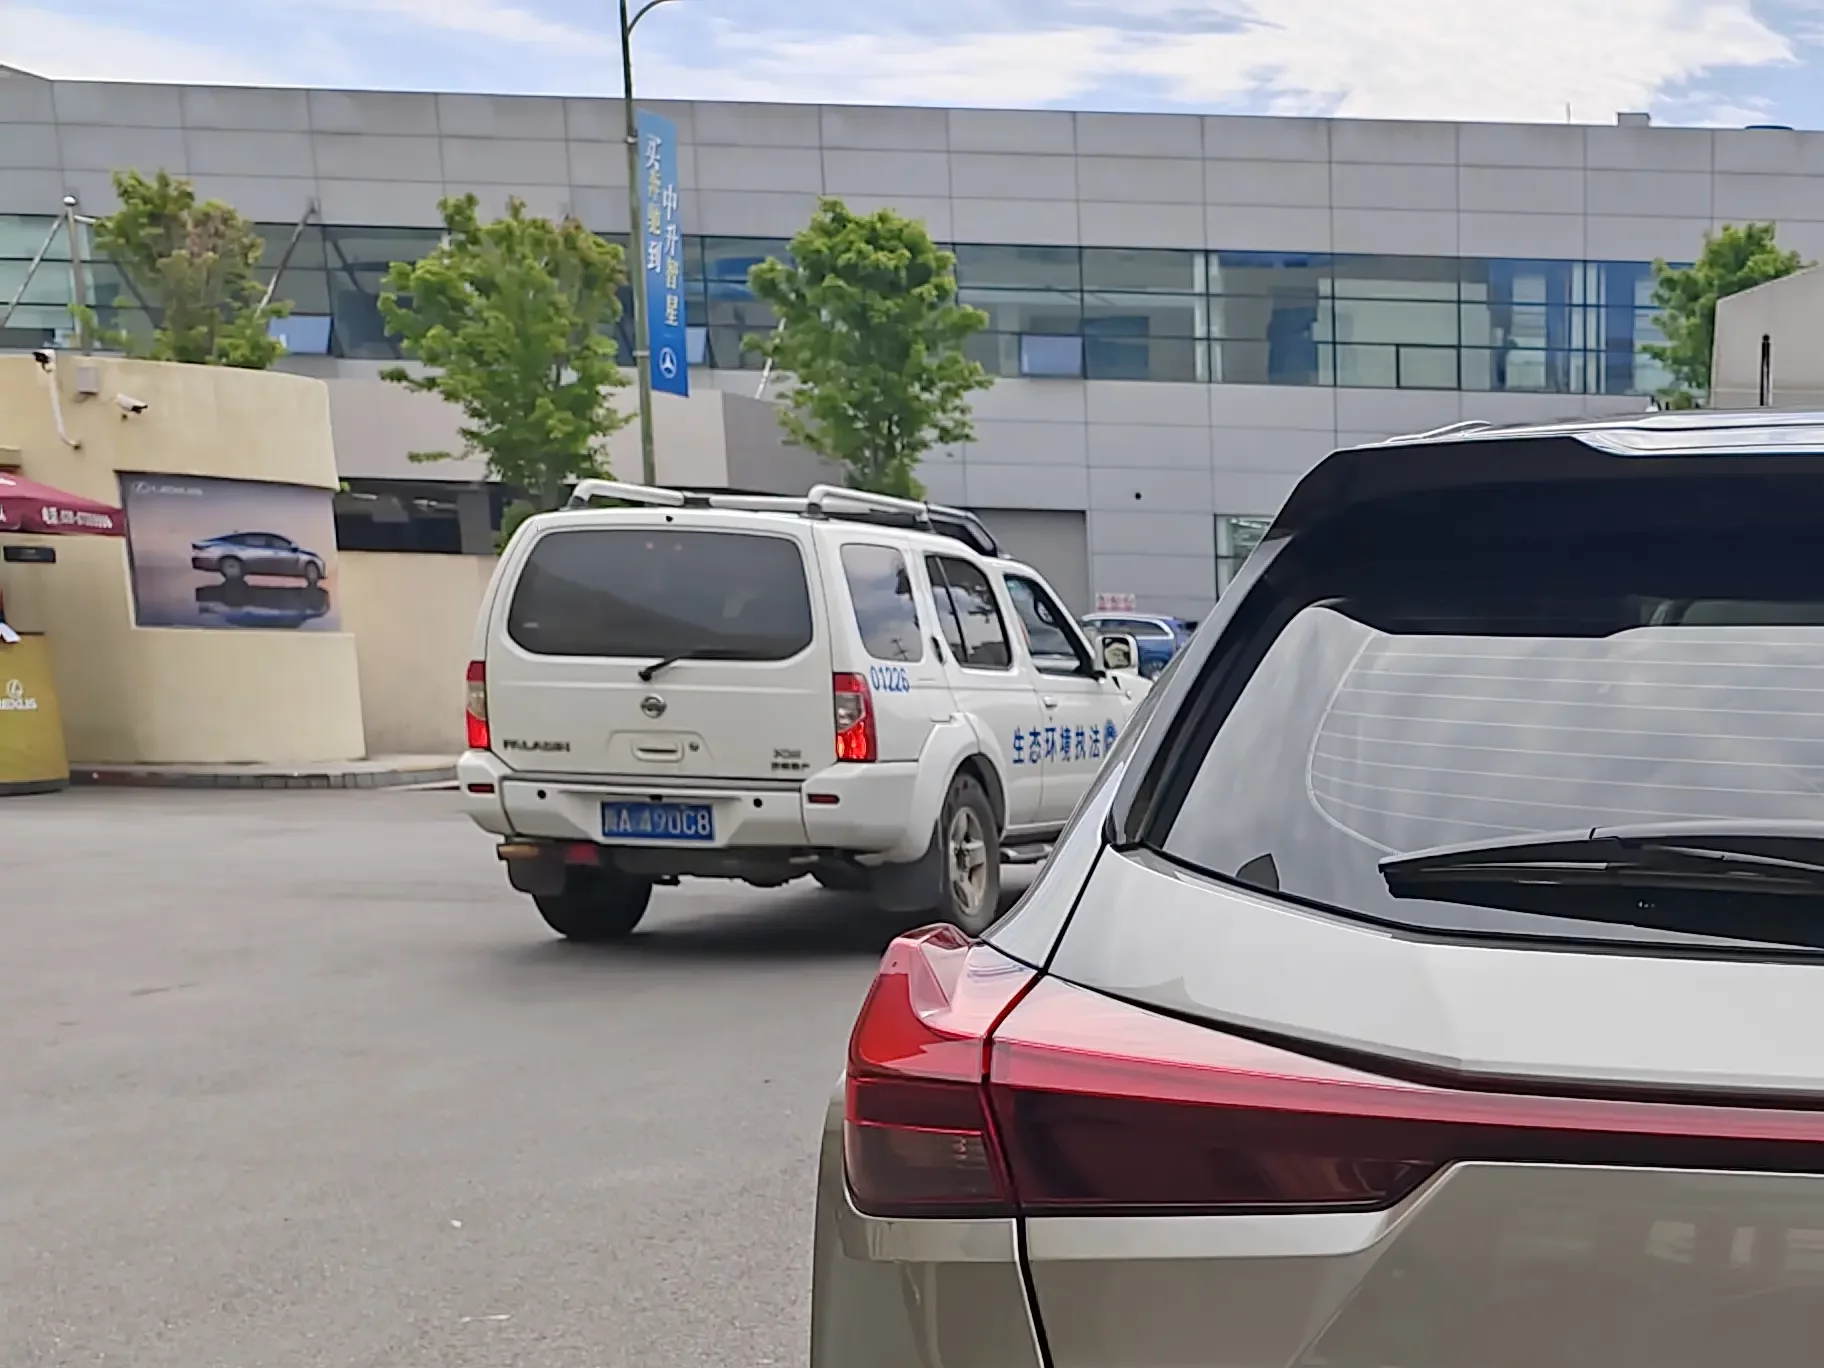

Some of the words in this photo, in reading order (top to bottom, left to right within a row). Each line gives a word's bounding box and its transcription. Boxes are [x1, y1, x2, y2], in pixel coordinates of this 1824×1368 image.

[663, 184, 679, 326] 中升智星
[870, 665, 911, 693] 01226
[1012, 724, 1101, 765] 生态环境执法
